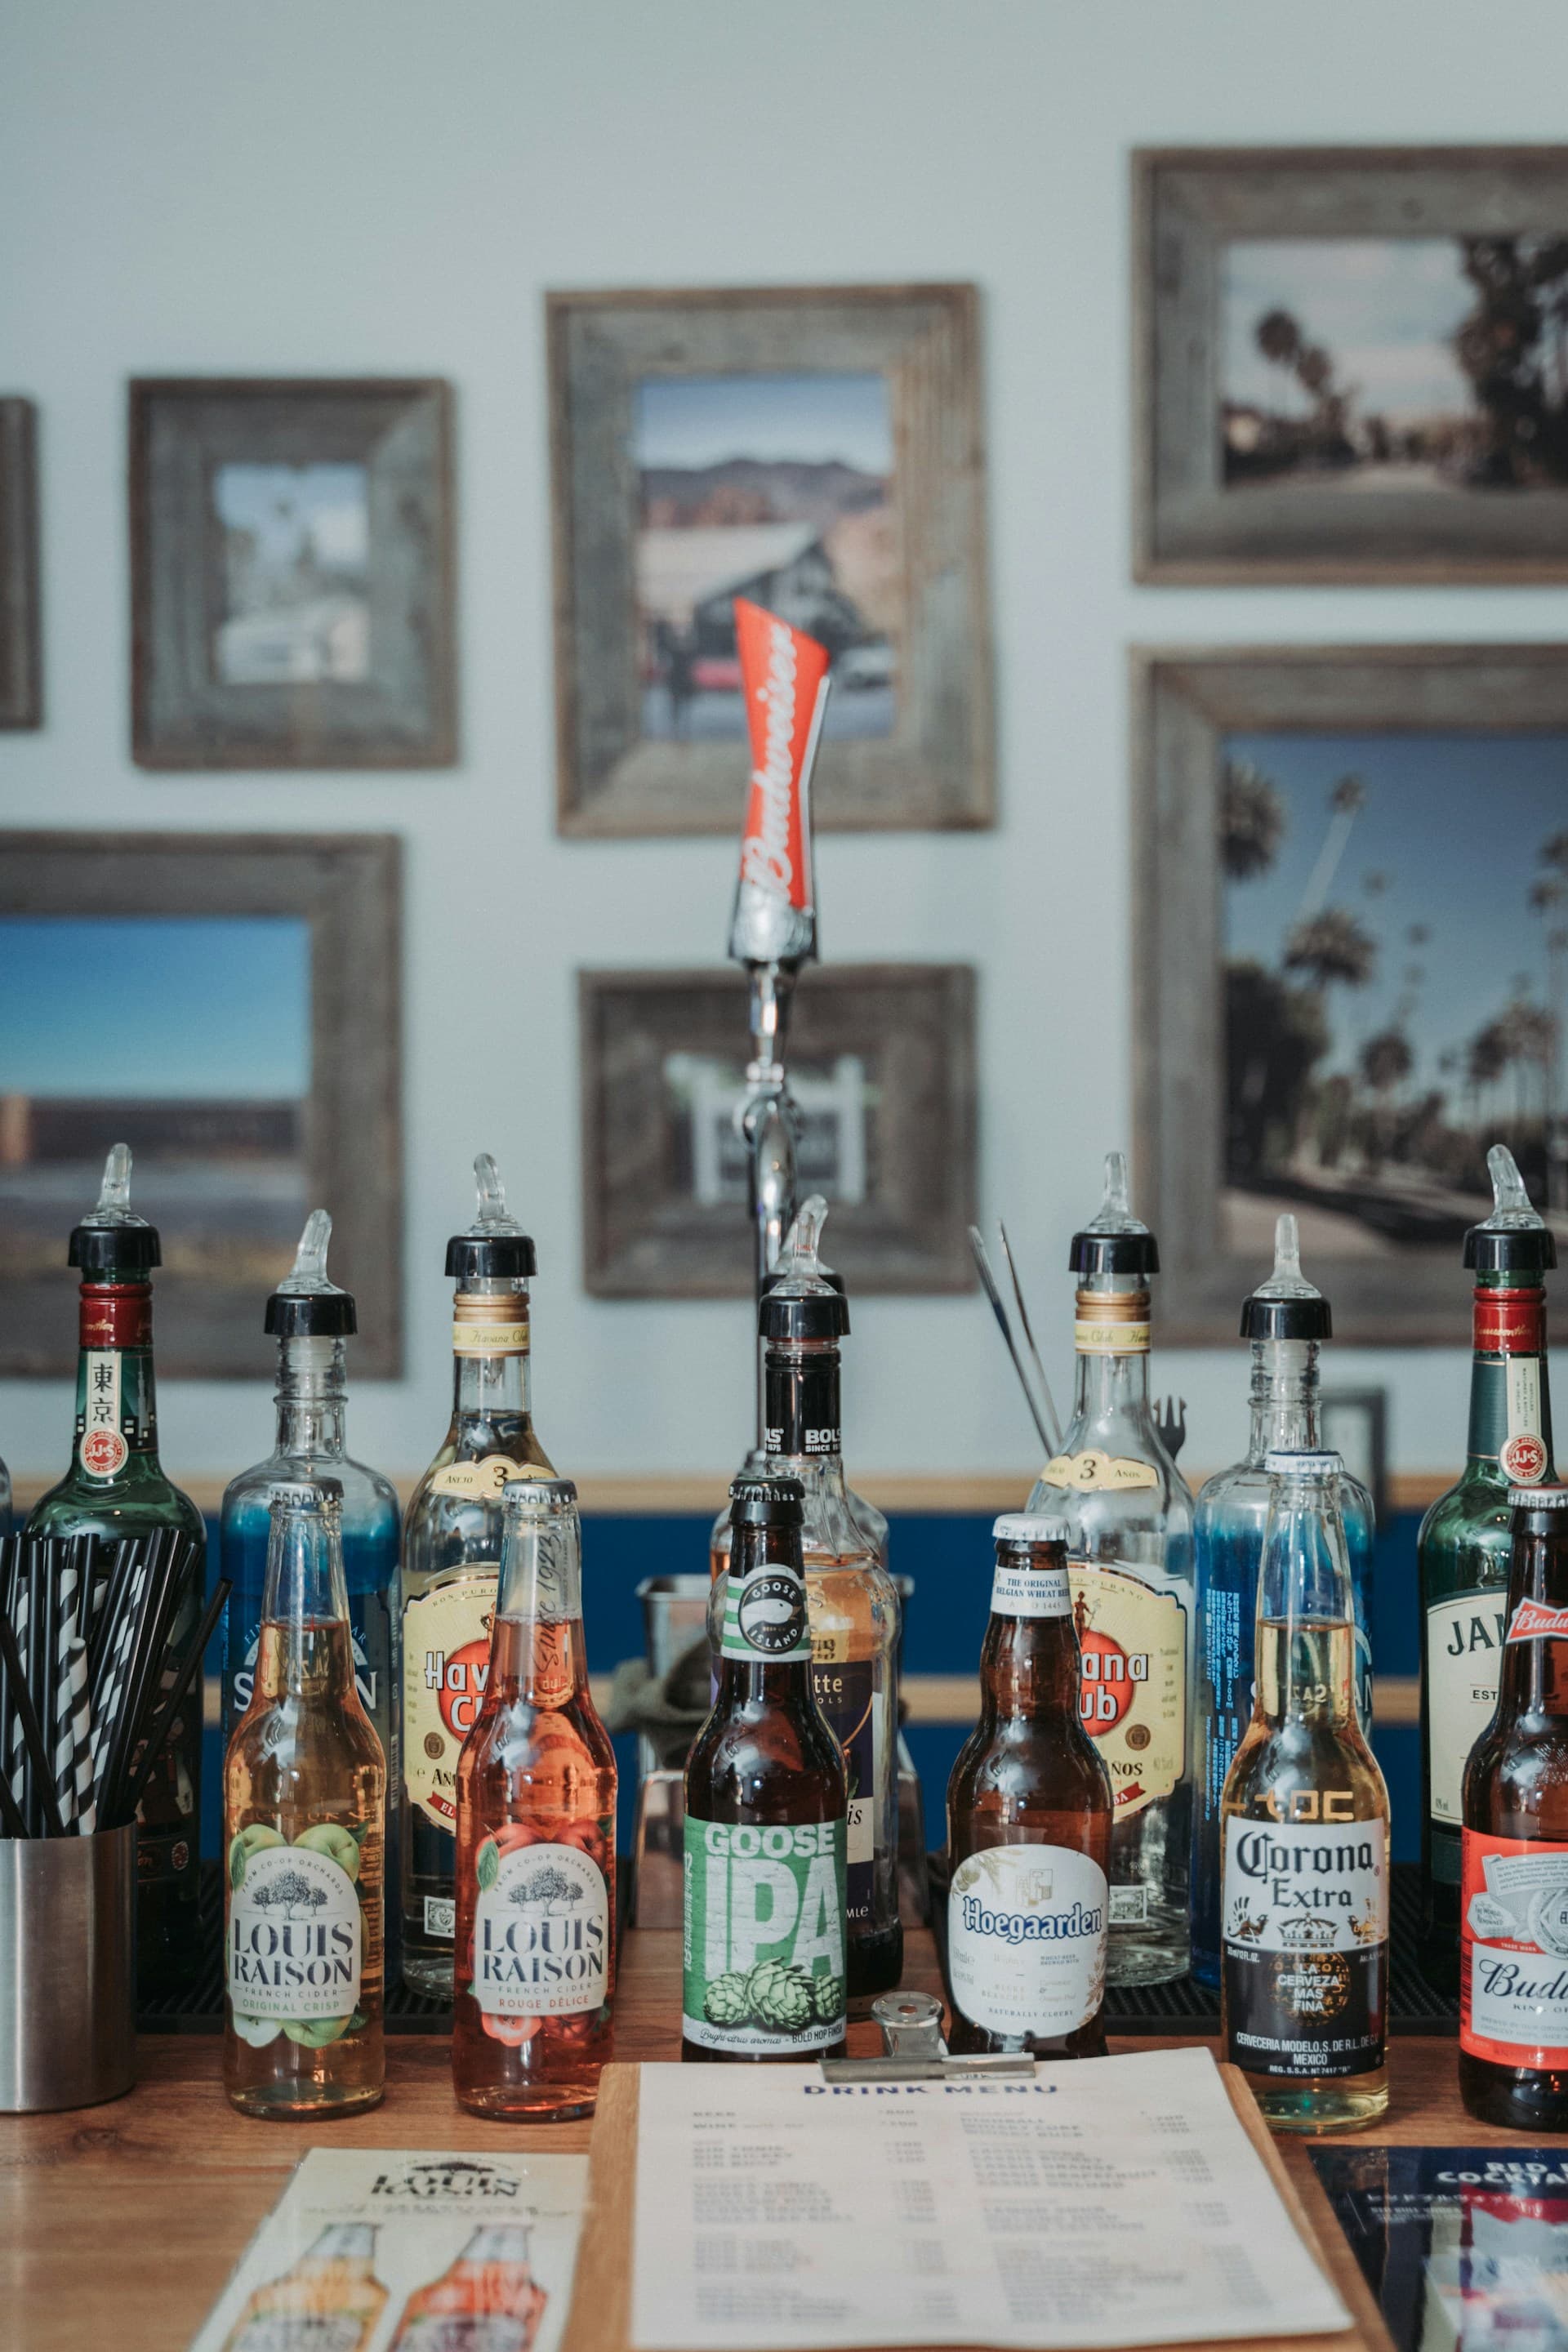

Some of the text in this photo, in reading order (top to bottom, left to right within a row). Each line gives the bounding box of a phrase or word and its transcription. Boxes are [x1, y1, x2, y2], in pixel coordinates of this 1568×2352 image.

[92, 1363, 114, 1423] 東京
[493, 1466, 509, 1487] 3
[1080, 1459, 1097, 1480] 3
[536, 1533, 563, 1593] 1923
[751, 1581, 796, 1600] GOOSE
[996, 1586, 1024, 1597] BELGIAN
[1027, 1589, 1056, 1597] WHEAT
[1007, 1578, 1061, 1588] THE ORIGINAL
[532, 1600, 559, 1673] Since
[750, 1628, 798, 1647] ISLAND
[425, 1650, 490, 1690] Hav
[1081, 1651, 1148, 1682] ana
[1080, 1685, 1118, 1722] ub
[1111, 1760, 1143, 1777] ÑOS
[705, 1821, 835, 1859] GOOSE
[1236, 1830, 1374, 1884] Corona
[299, 1859, 344, 1895] ORCHARDS
[557, 1855, 597, 1889] ORCHARDS
[1272, 1878, 1352, 1908] Extra
[705, 1855, 844, 1981] IPA
[963, 1895, 1102, 1944] Hoegaarden
[234, 1918, 354, 1958] LOUIS
[483, 1914, 604, 1953] LOUIS
[234, 1954, 353, 1986] RAISON
[483, 1949, 604, 1982] RAISON
[1299, 1964, 1318, 1974] LA
[498, 1982, 591, 1994] FRENCH CIDER
[1277, 1975, 1339, 1986] CERVEZA
[245, 1988, 337, 1998] FRENCH CIDER
[499, 1995, 589, 2008] ROUGE DÉLICE
[1294, 1989, 1324, 1999] MAS
[243, 1998, 340, 2012] ORIGINAL CRISP
[1293, 2000, 1325, 2011] FINA
[1513, 2003, 1546, 2013] KIN
[751, 2037, 782, 2045] aromas
[792, 2033, 813, 2043] BOLD
[813, 2029, 827, 2042] HOP
[1236, 2032, 1281, 2051] CERVECERIA
[1333, 2040, 1344, 2051] DE
[1345, 2038, 1360, 2051] R.L.
[1293, 2053, 1328, 2065] MEXICO
[803, 2085, 1058, 2096] DRINK MENU
[1485, 2162, 1548, 2173] RED
